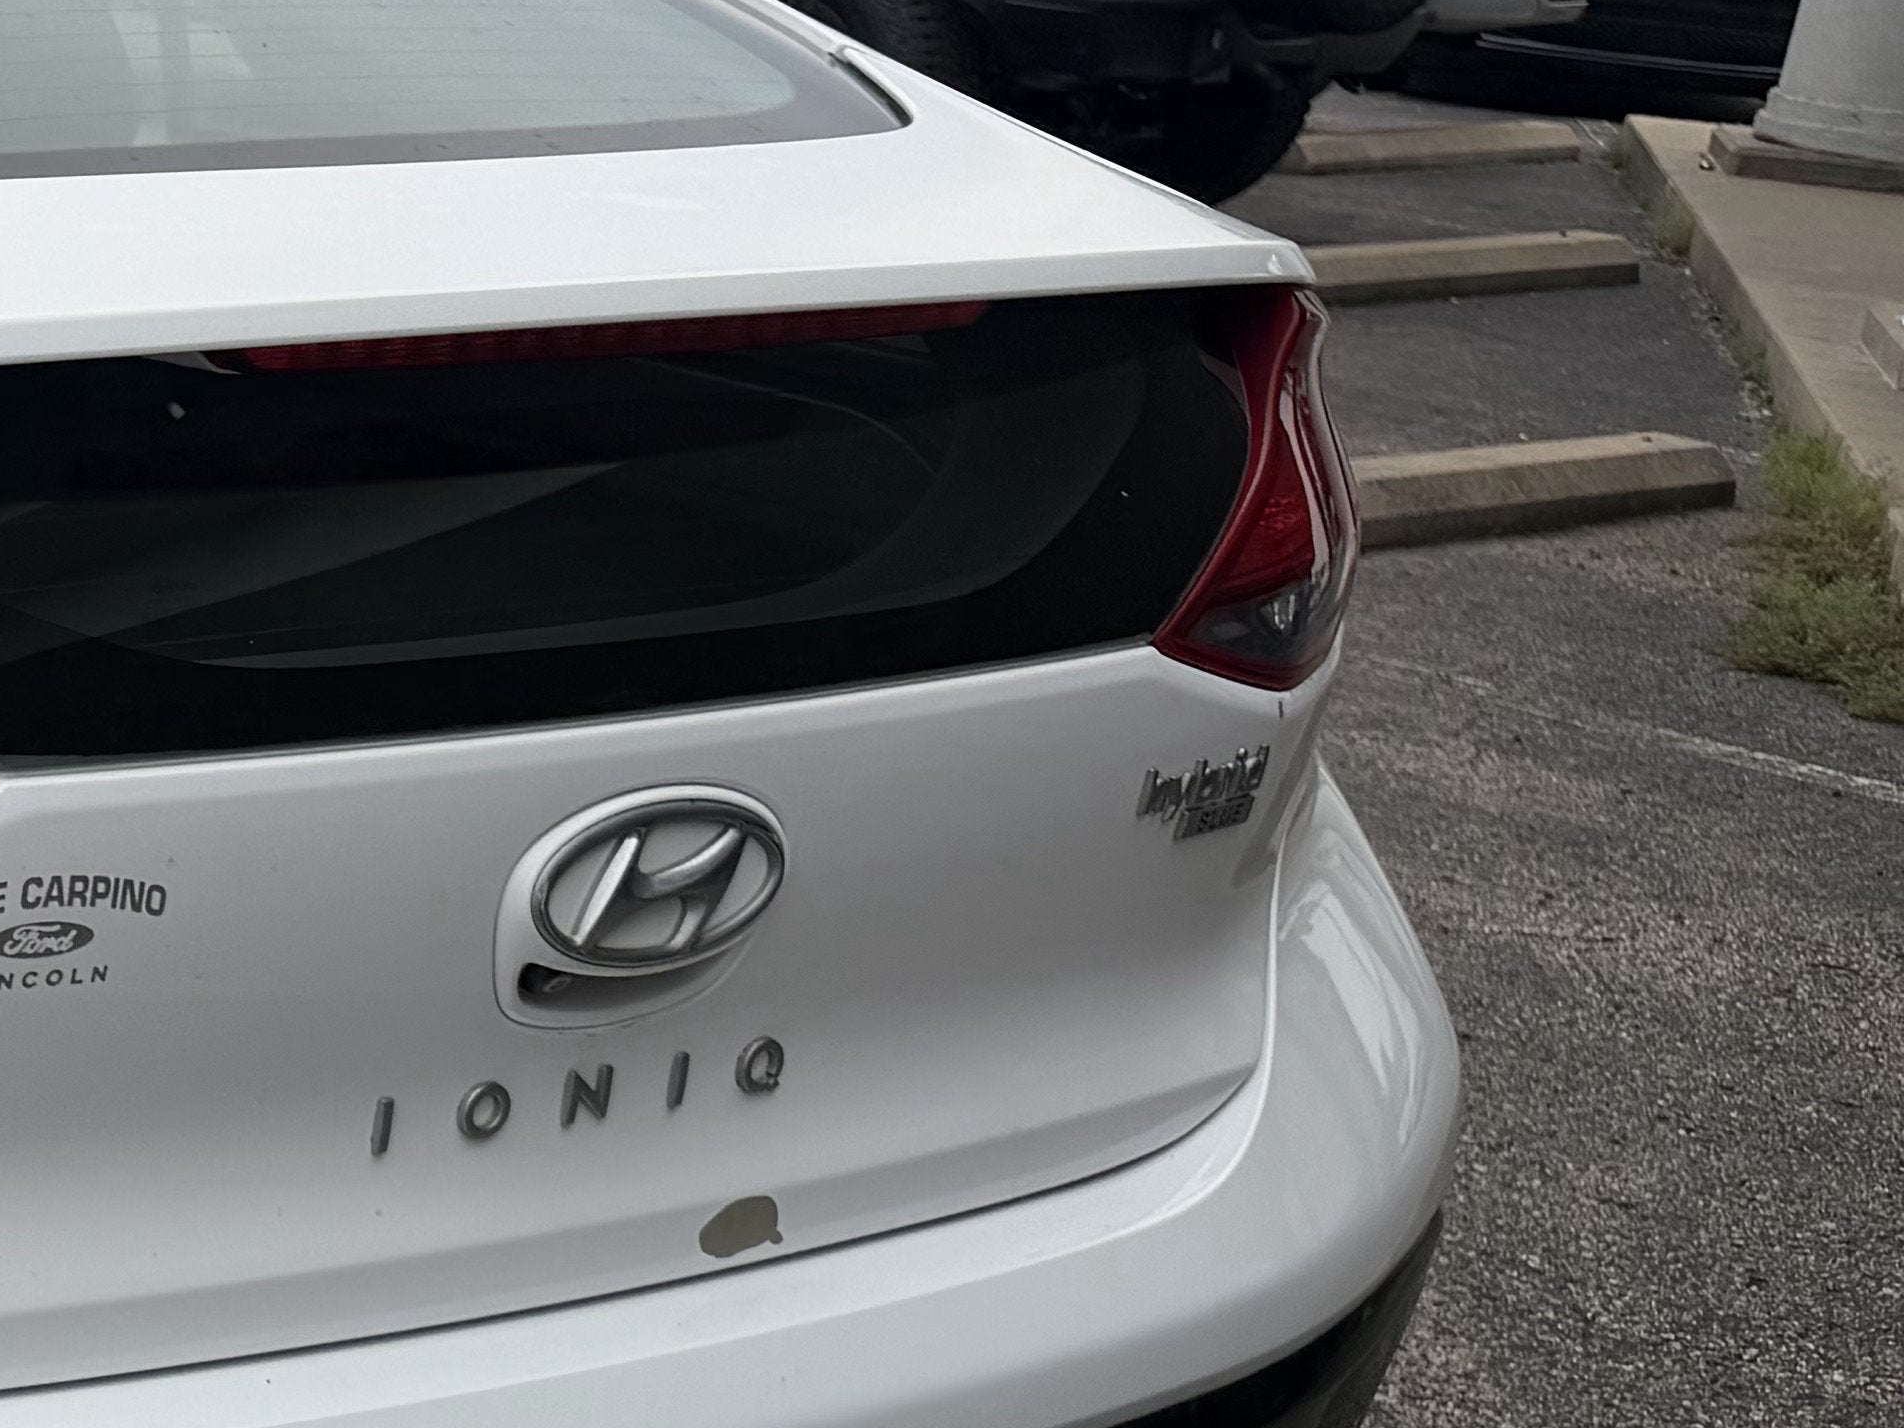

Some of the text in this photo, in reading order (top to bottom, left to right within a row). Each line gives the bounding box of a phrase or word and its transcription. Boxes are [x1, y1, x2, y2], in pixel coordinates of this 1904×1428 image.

[1136, 743, 1270, 824] hybrid
[20, 875, 167, 917] CARPINO
[370, 1035, 785, 1157] IONIQ
